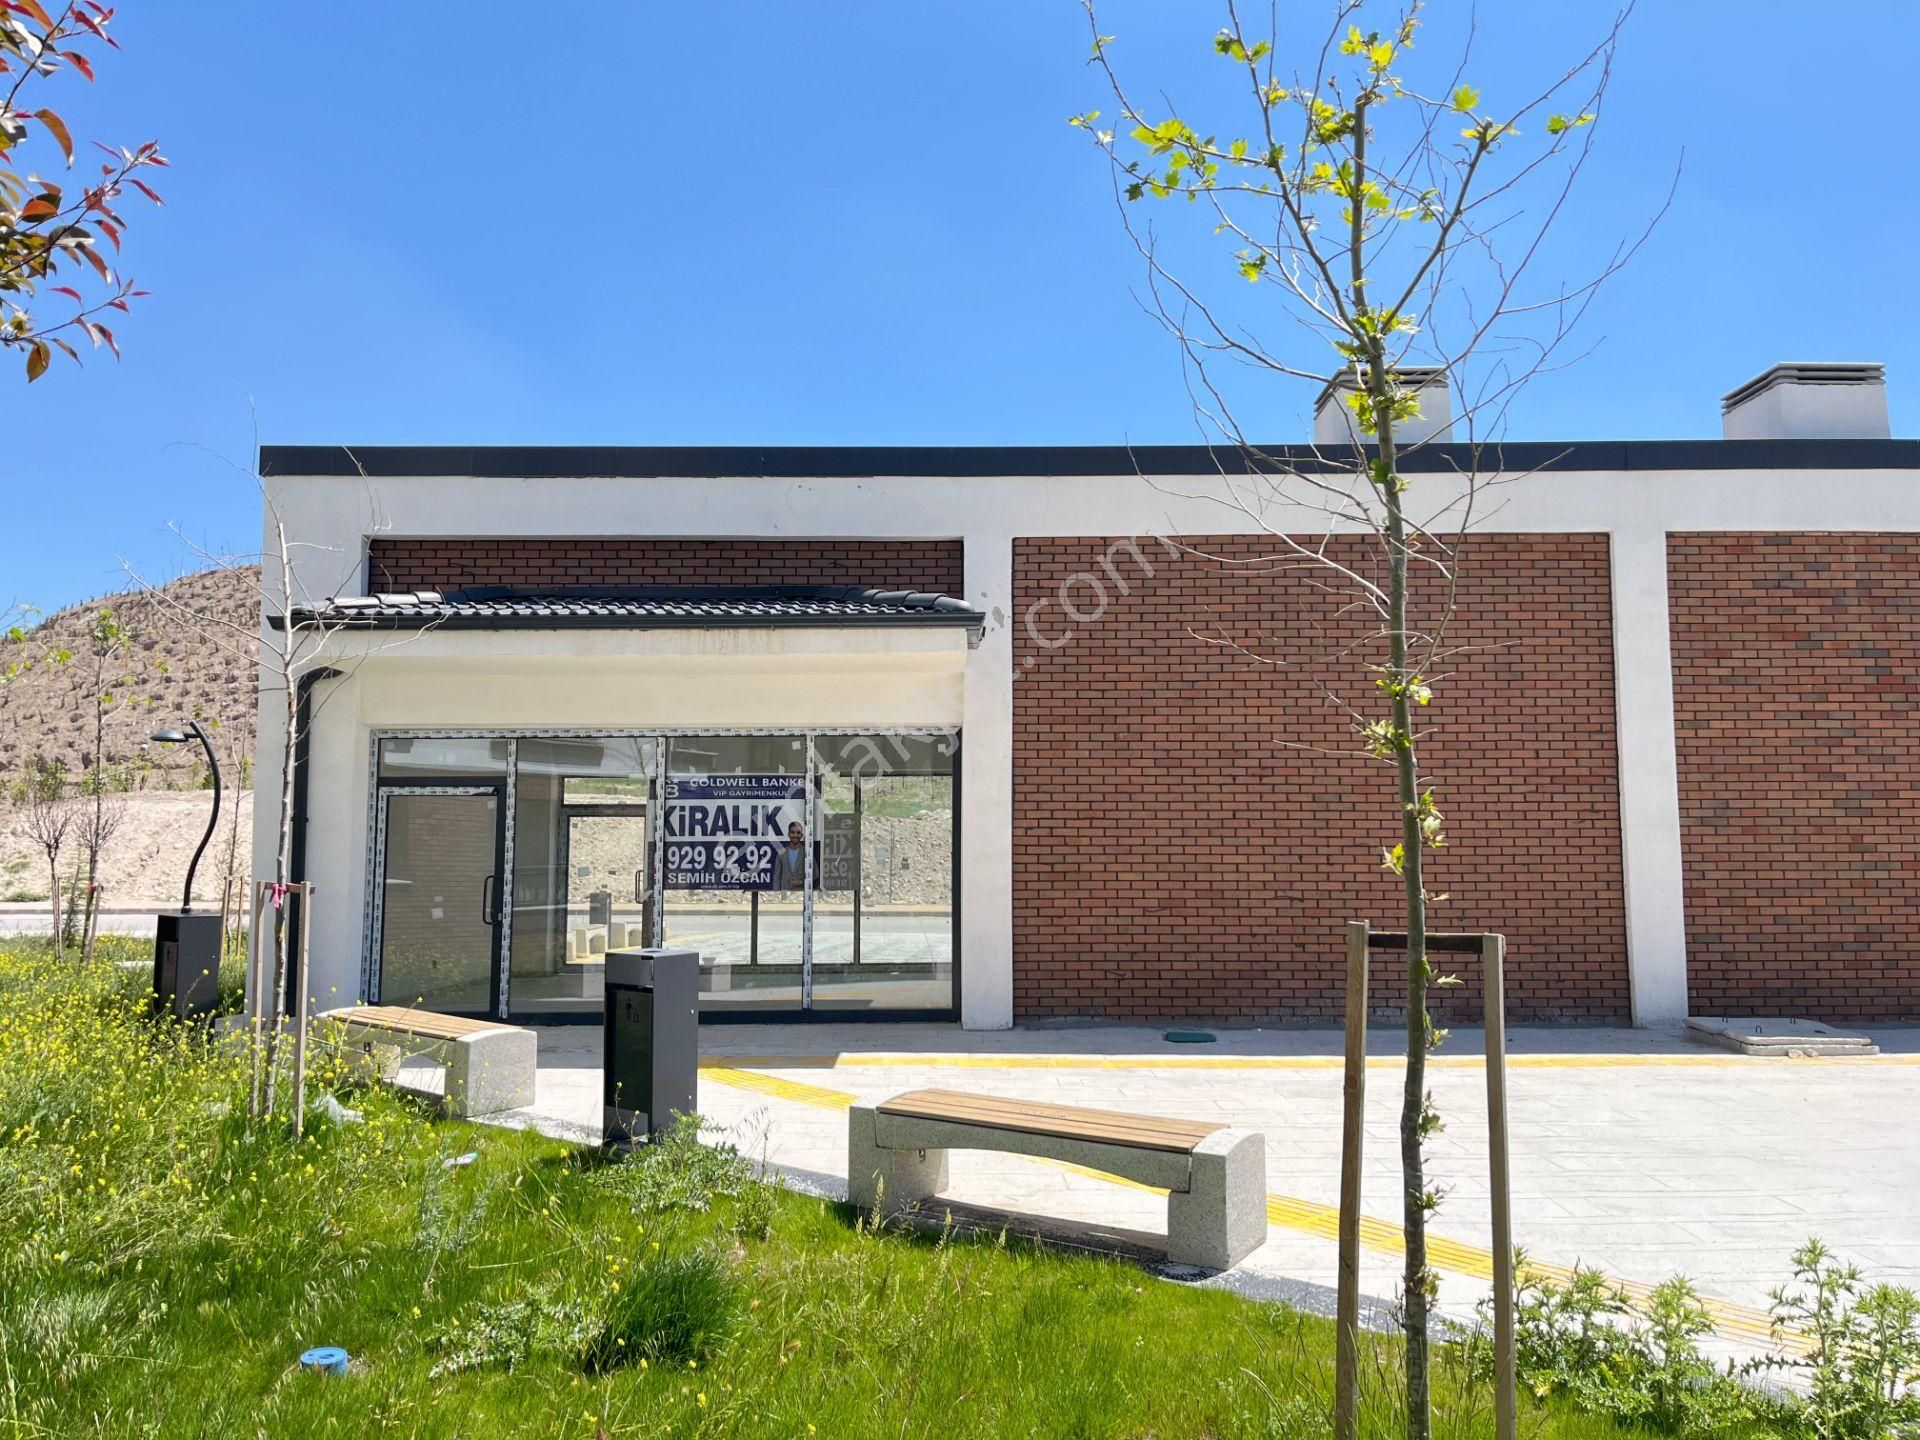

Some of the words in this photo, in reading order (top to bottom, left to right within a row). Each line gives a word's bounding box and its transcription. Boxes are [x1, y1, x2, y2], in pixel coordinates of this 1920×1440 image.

[690, 778, 758, 787] COLDWELL
[762, 778, 805, 787] BANKE
[667, 846, 707, 869] 929
[713, 846, 739, 869] 92
[746, 846, 772, 869] 92
[667, 870, 715, 883] SEMİH
